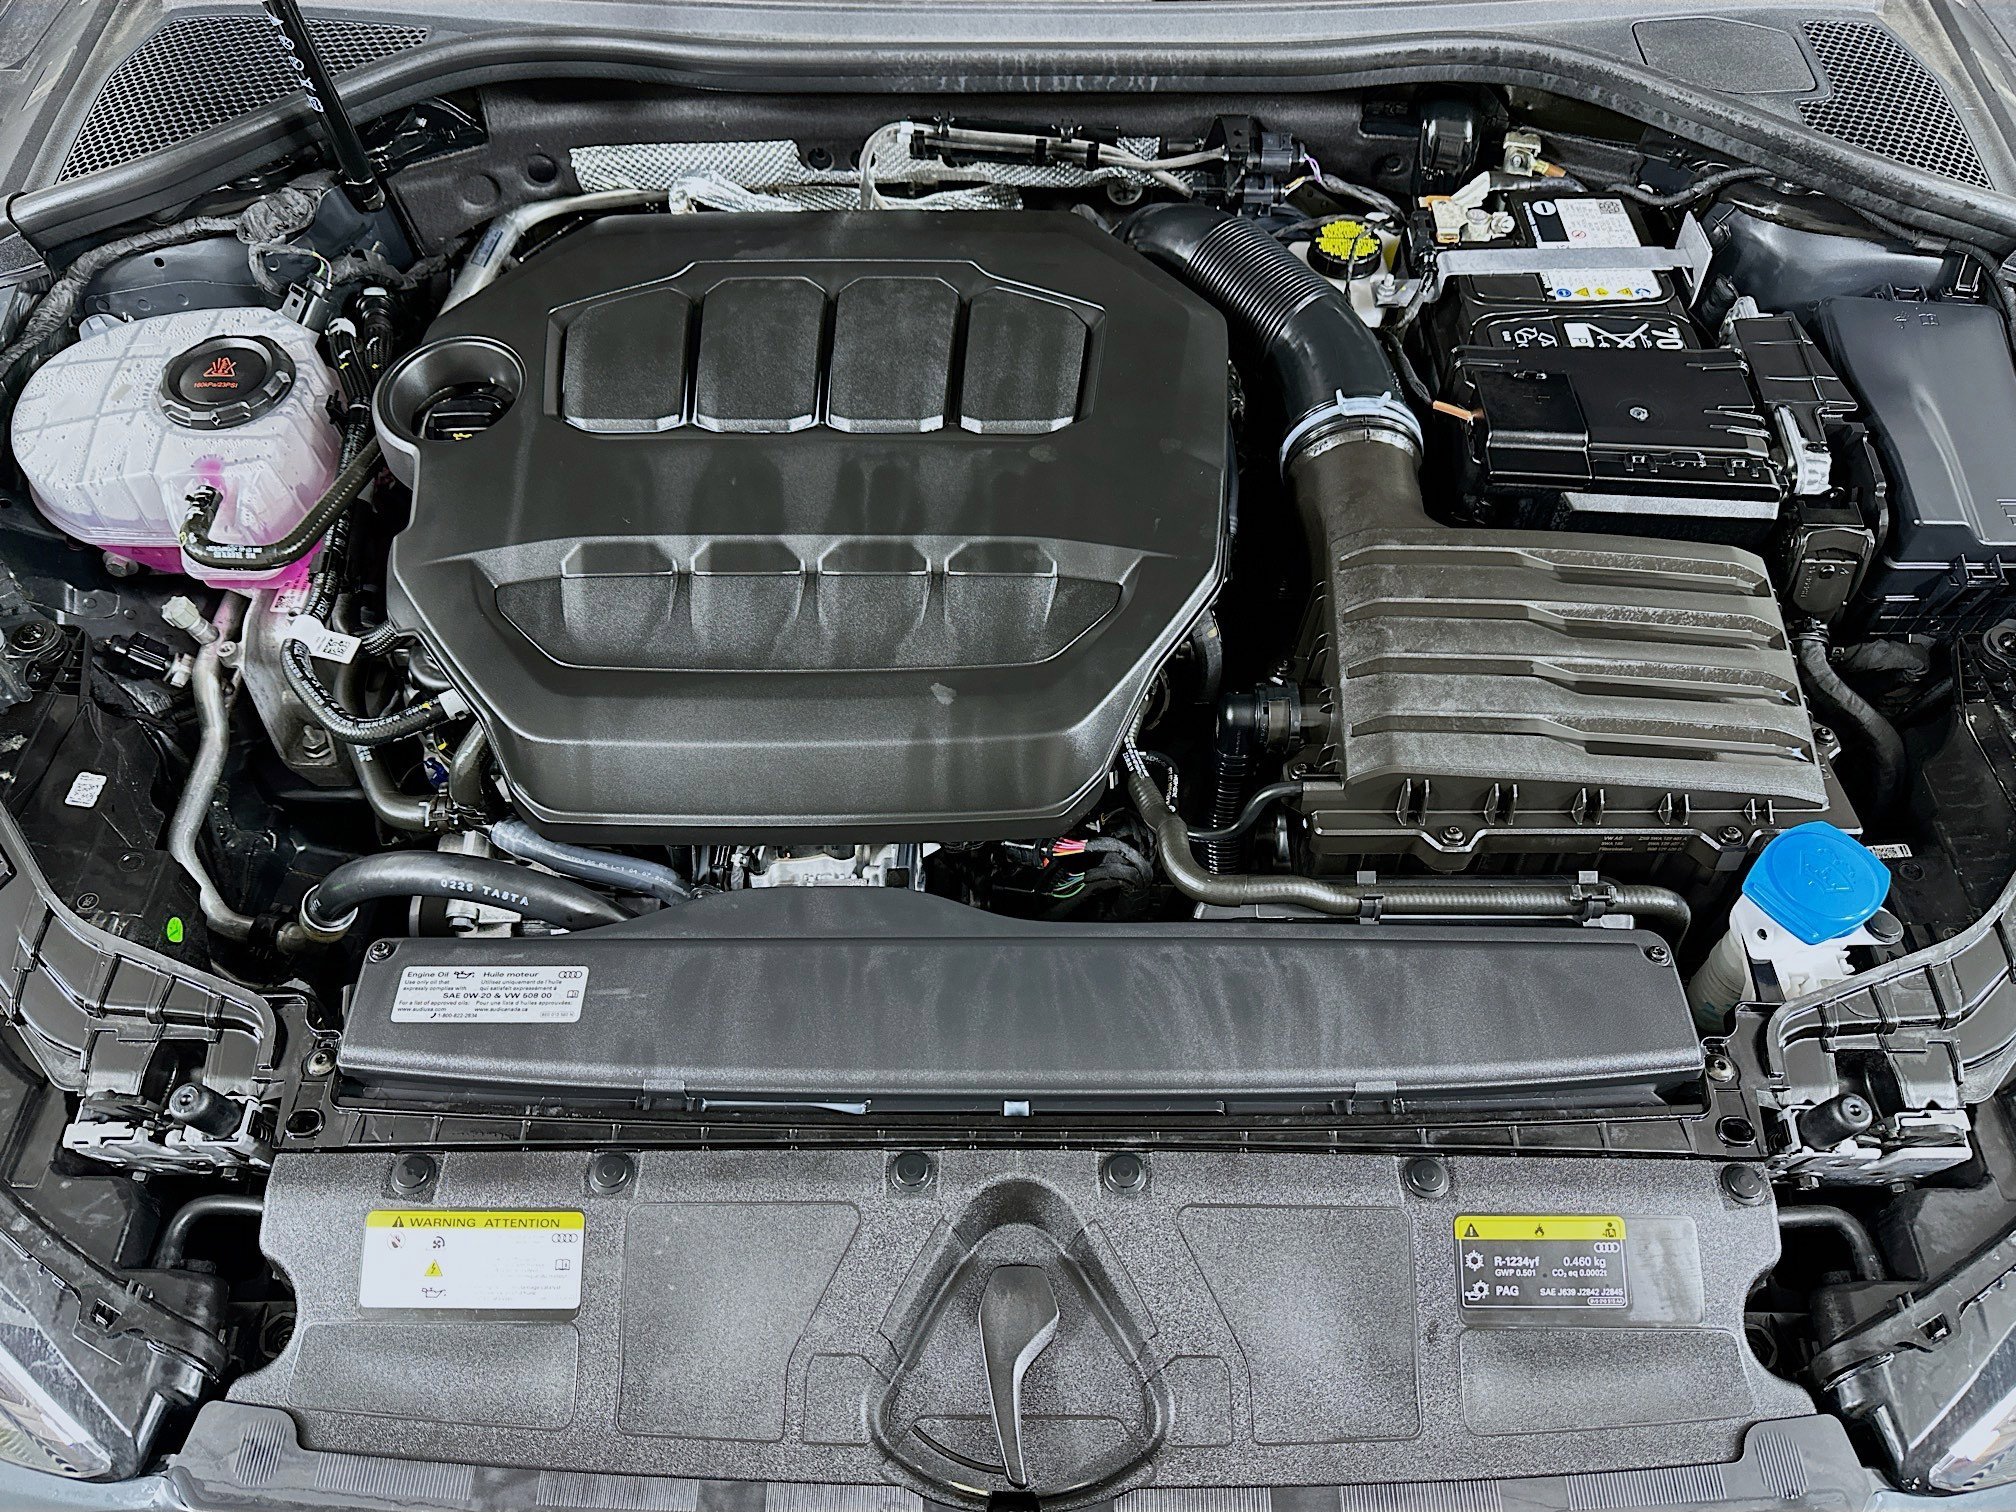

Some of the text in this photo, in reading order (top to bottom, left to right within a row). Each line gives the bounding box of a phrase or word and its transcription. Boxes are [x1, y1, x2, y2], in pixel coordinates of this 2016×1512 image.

[1651, 327, 1684, 349] 70
[410, 1218, 560, 1228] WARNING ATTENTION
[1494, 1256, 1606, 1268] R-1234yf 0.460 kg
[1495, 1269, 1514, 1277] GWP
[1515, 1269, 1536, 1277] 0.501
[1568, 1270, 1578, 1278] eq
[1579, 1269, 1608, 1277] 0.0002t
[1496, 1286, 1623, 1296] PAG SAE J639 J2842 J2845
